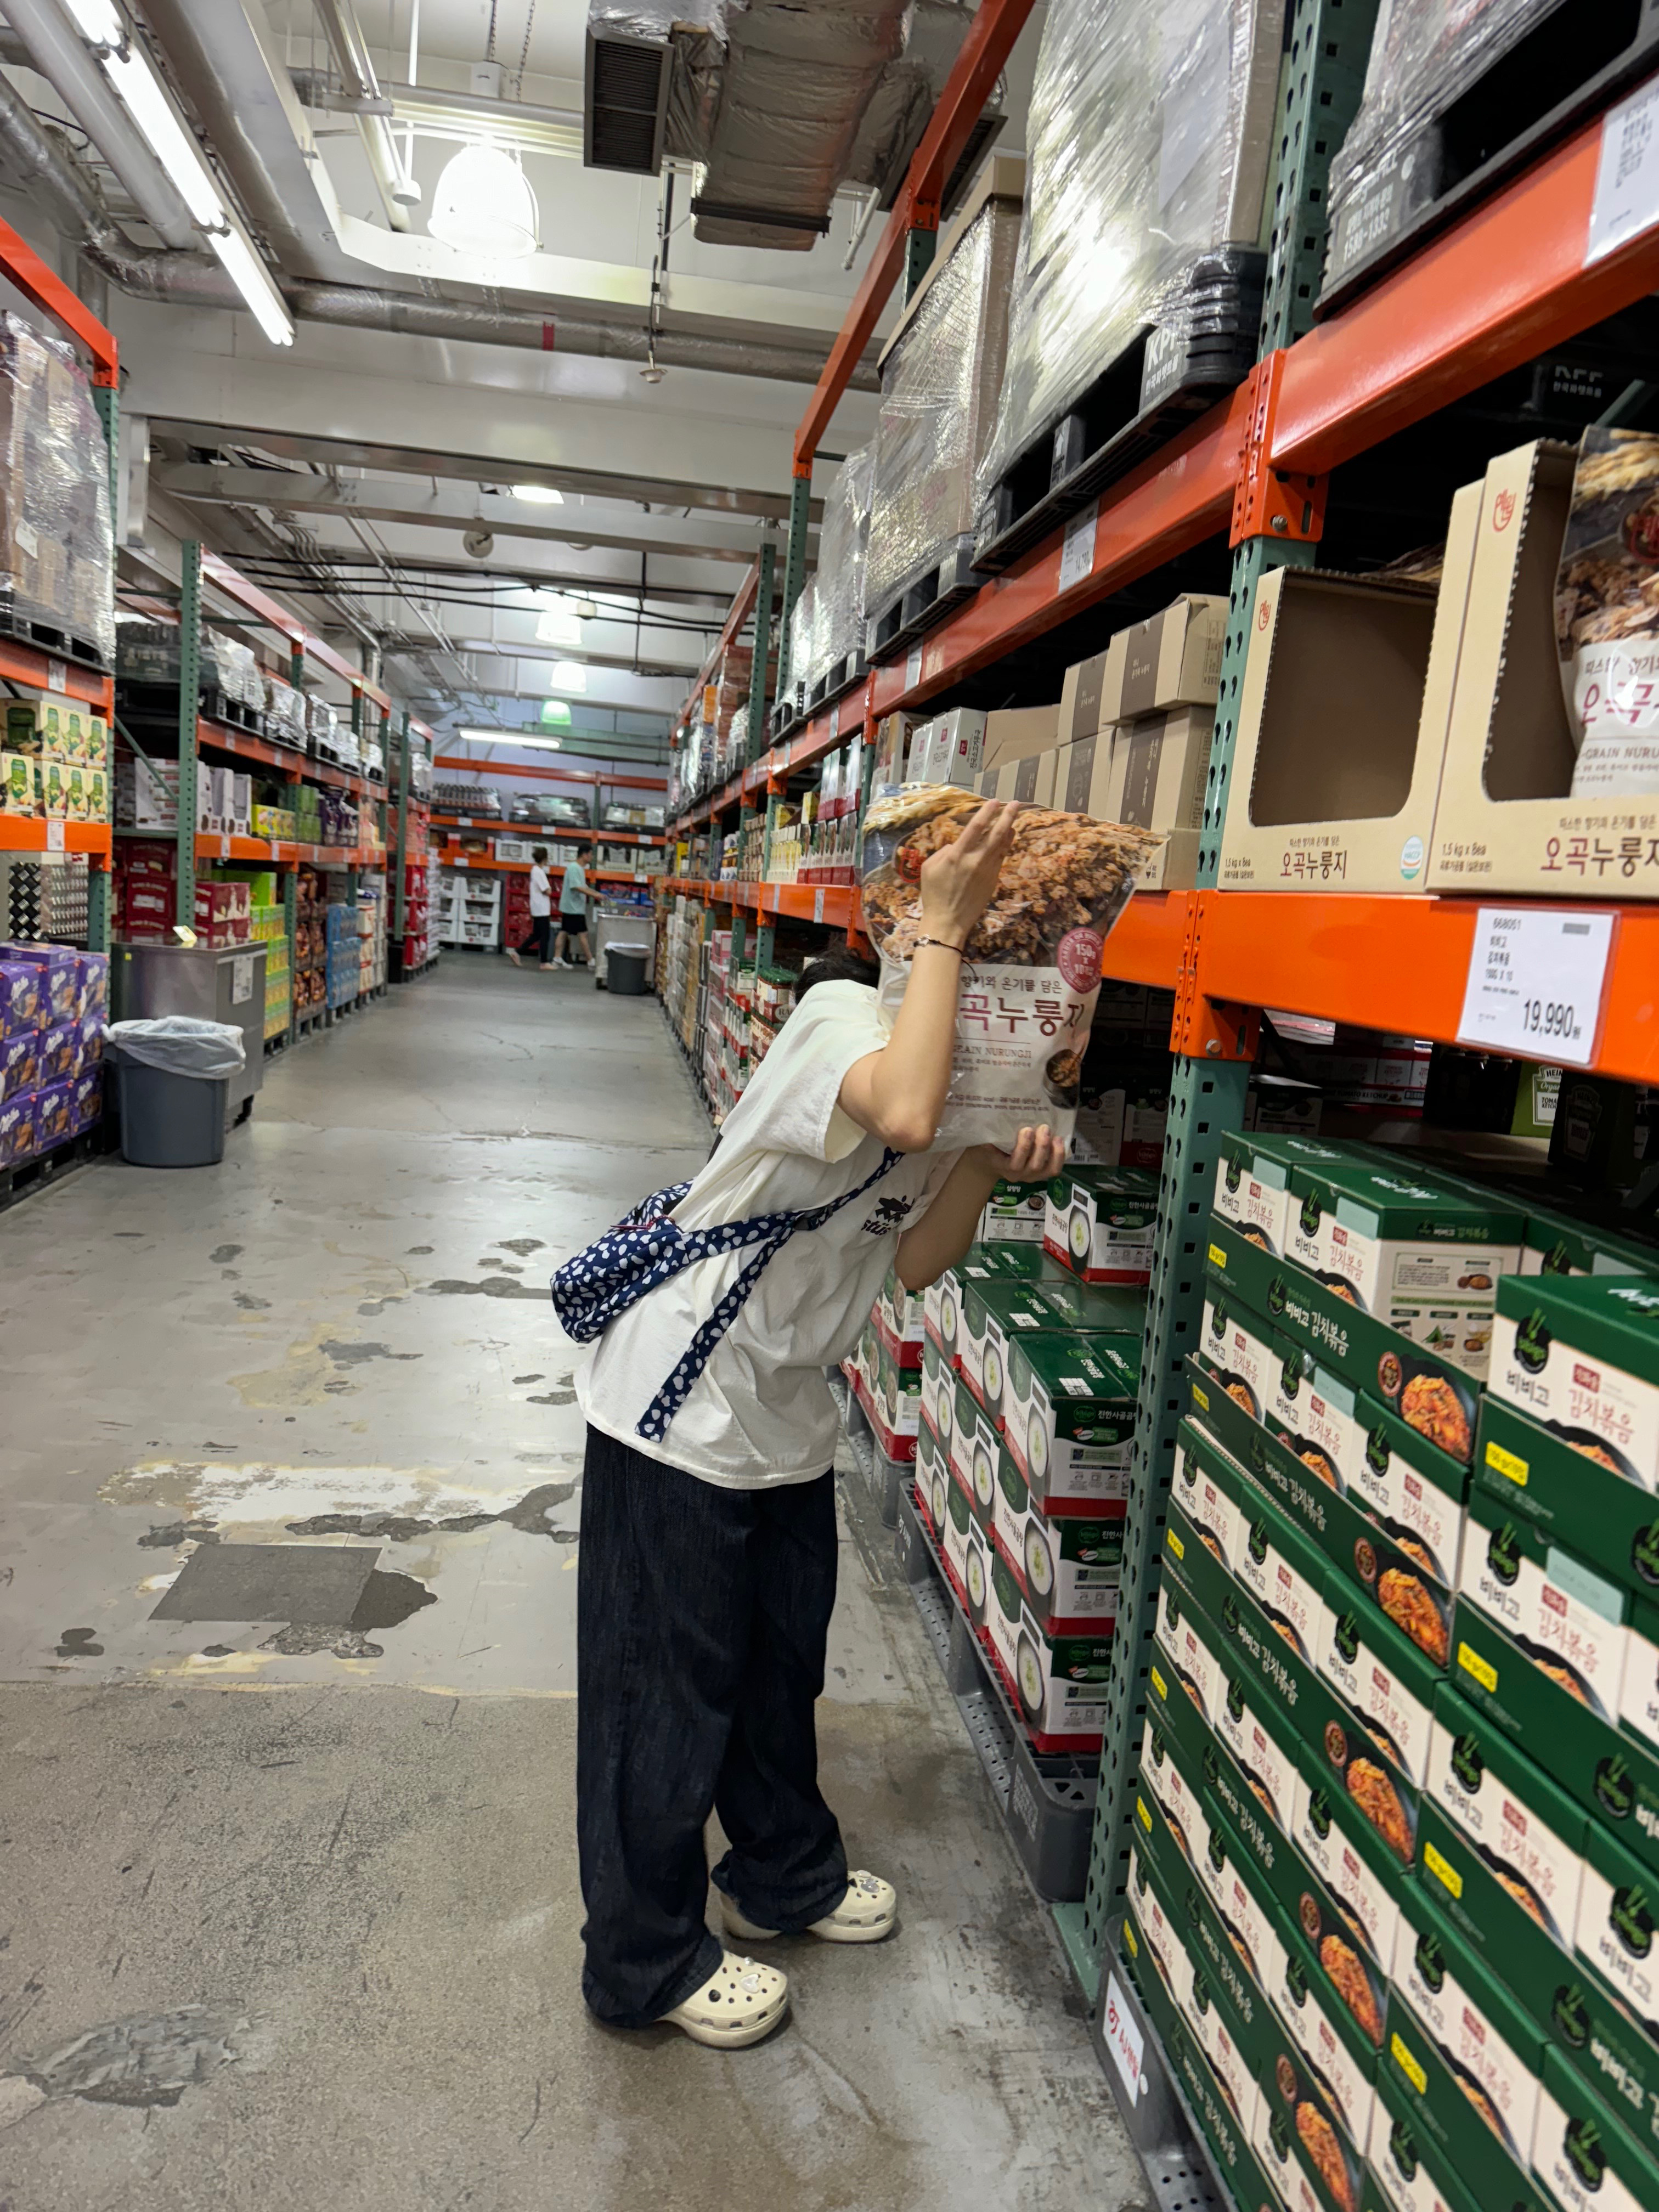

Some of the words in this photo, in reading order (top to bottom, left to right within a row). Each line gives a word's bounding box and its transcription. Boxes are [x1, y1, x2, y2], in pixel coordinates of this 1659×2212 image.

[1280, 850, 1348, 879] 오곡누룽지
[1001, 977, 1036, 992] 온기를
[1040, 980, 1063, 994] 담은
[960, 994, 1085, 1036] 곡누룽지
[985, 1048, 1032, 1058] NURUNGJI
[1221, 1193, 1239, 1214] 비비고
[861, 1220, 891, 1235] stüs
[1295, 1235, 1319, 1261] 비비고
[1330, 1245, 1364, 1282] 김치볶음
[1285, 1300, 1310, 1328] 비비고
[1311, 1311, 1350, 1358] 김치볶음
[1208, 1337, 1226, 1361] 비비고
[1277, 1397, 1299, 1425] 비비고
[1506, 1369, 1550, 1407] 비비고
[1568, 1388, 1635, 1445] 김치볶음
[1361, 1470, 1390, 1506] 비비고
[1102, 1531, 1124, 1539] 진한사
[1480, 1575, 1520, 1621] 비비고
[1093, 1648, 1112, 1657] 진한사
